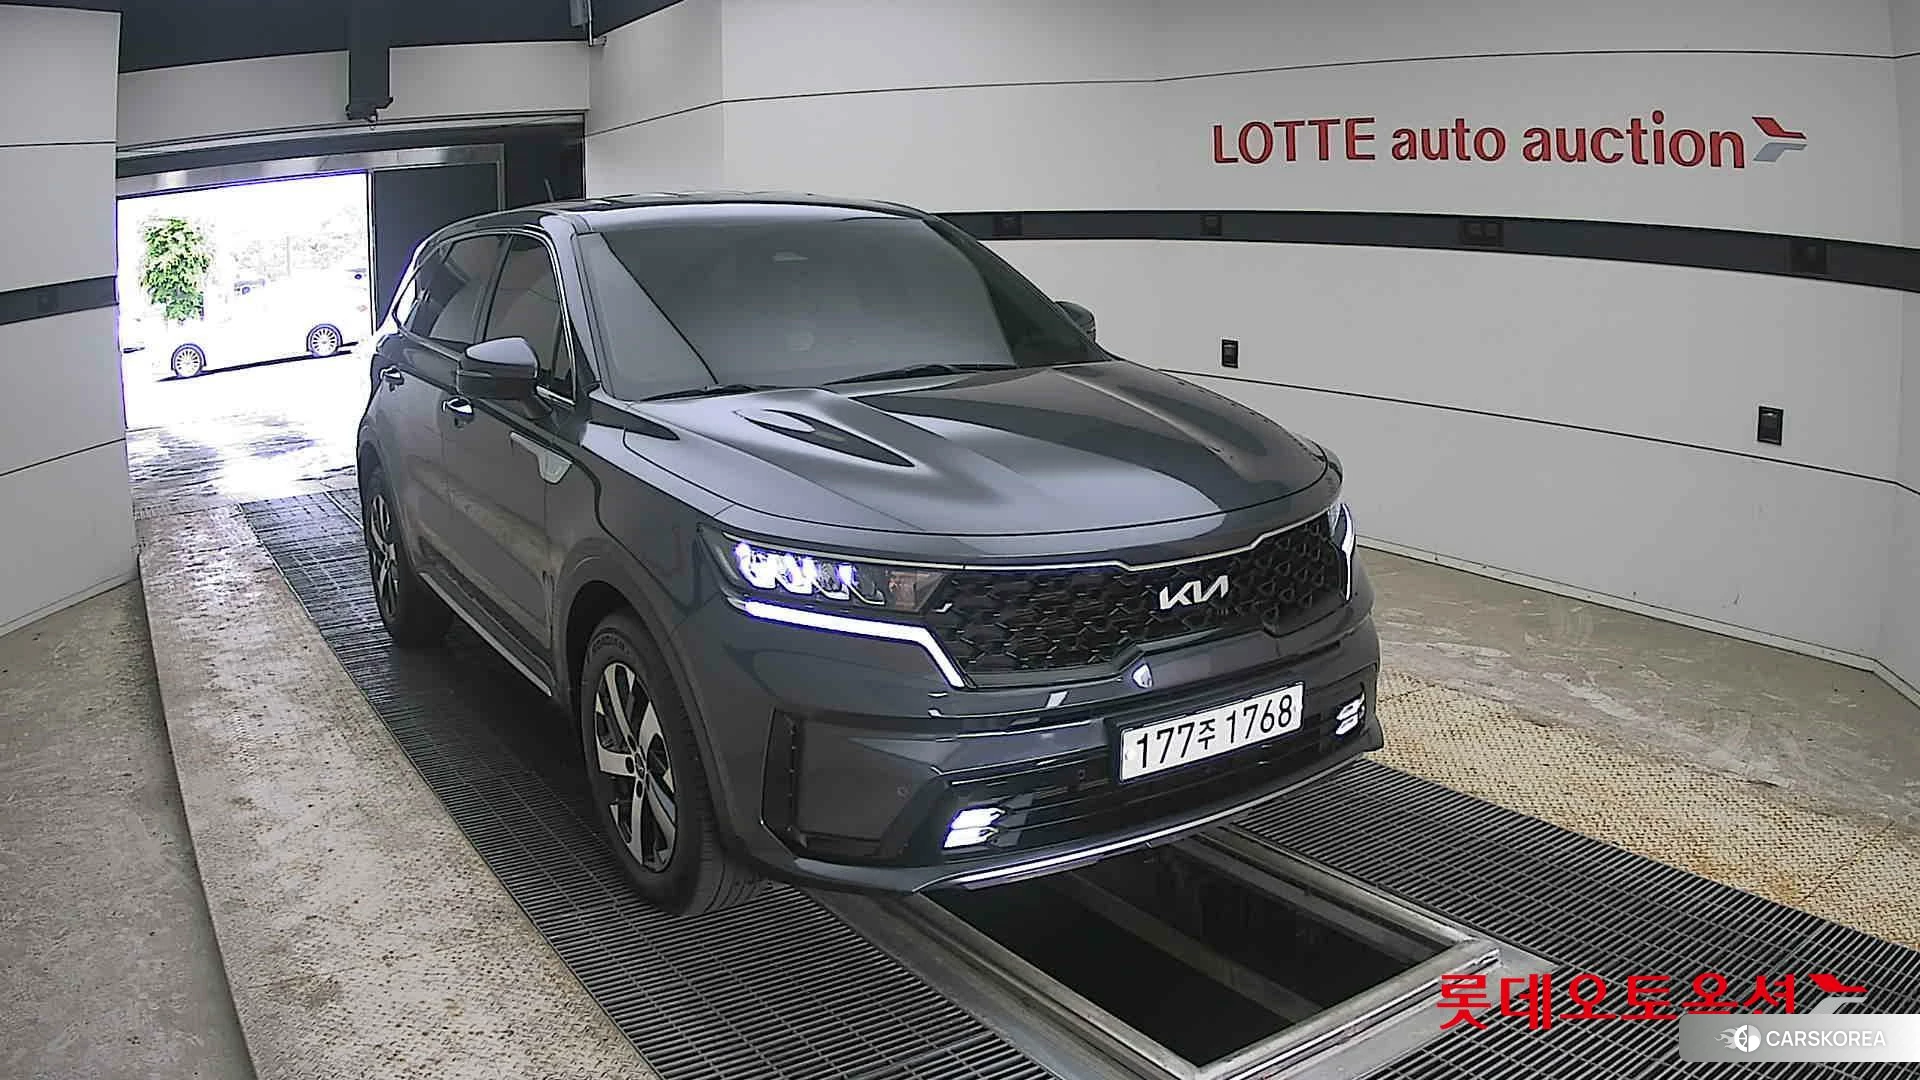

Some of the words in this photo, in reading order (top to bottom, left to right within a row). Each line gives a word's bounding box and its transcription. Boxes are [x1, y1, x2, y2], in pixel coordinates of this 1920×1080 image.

[1212, 116, 1376, 164] LOTTE
[1391, 118, 1505, 161] auto
[1522, 110, 1746, 169] auction
[1159, 575, 1229, 610] KIA
